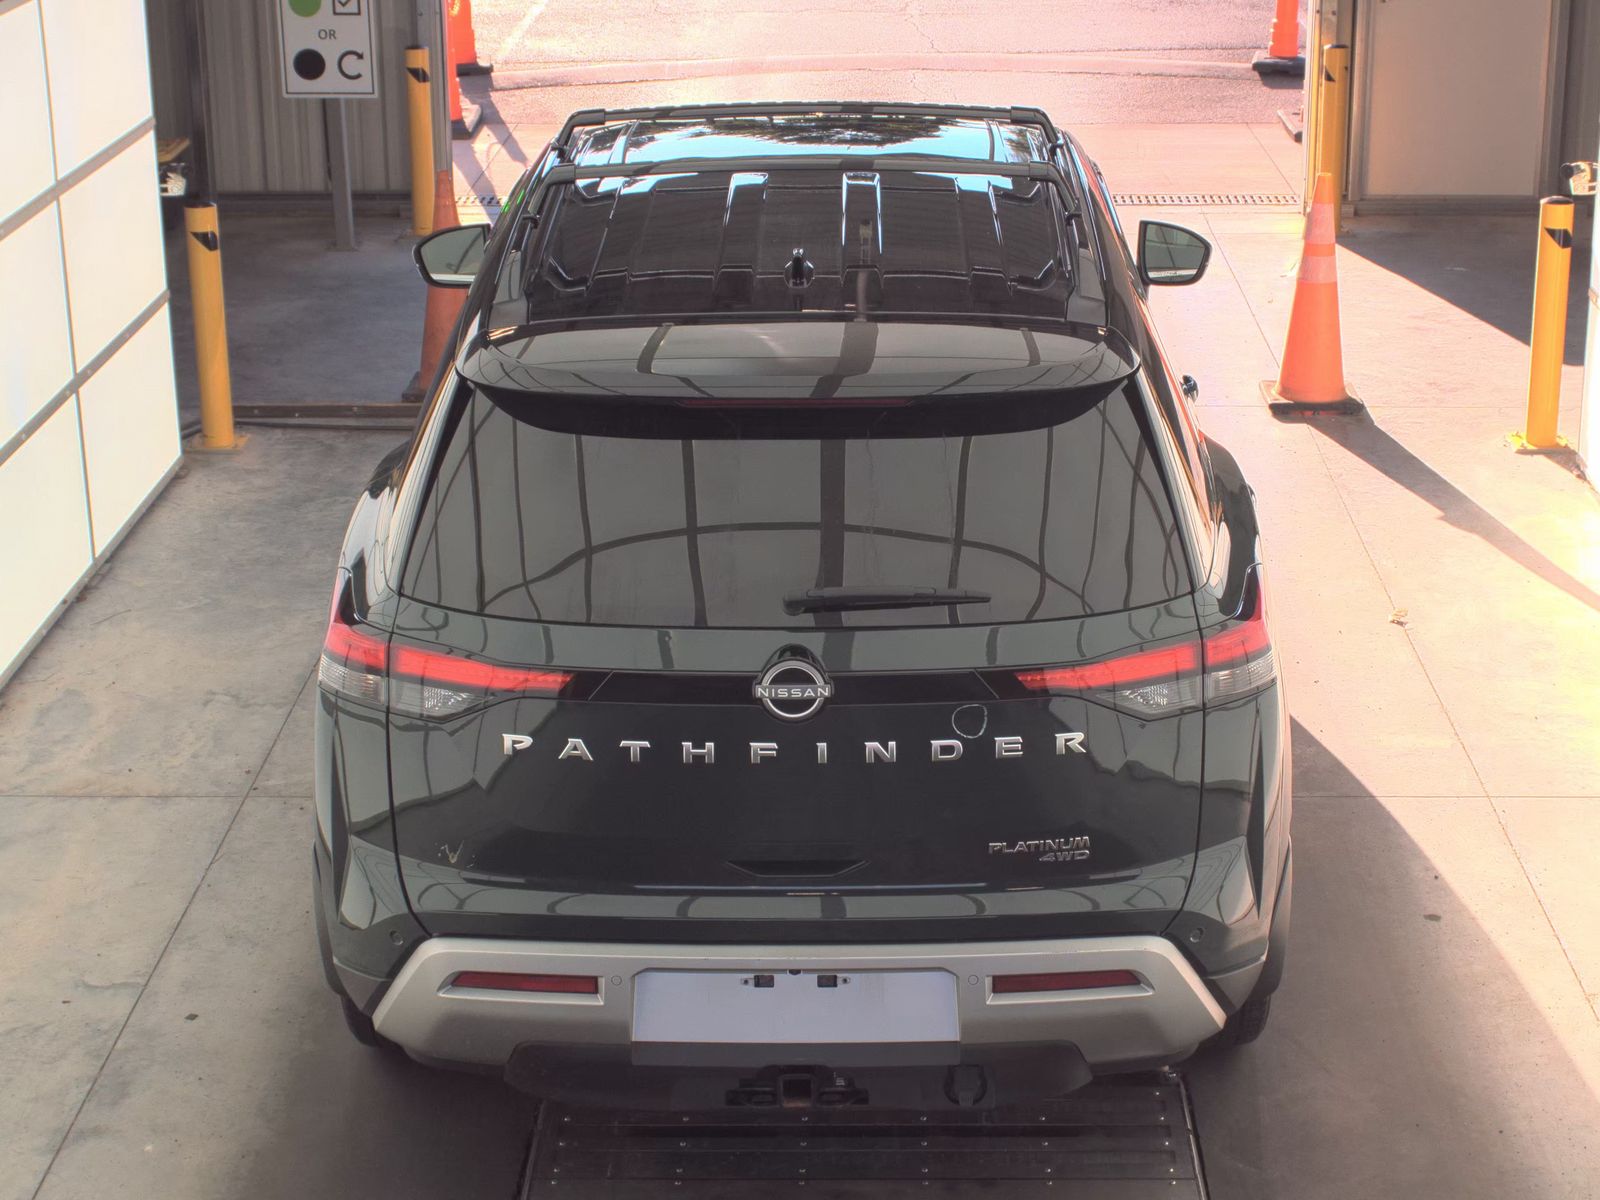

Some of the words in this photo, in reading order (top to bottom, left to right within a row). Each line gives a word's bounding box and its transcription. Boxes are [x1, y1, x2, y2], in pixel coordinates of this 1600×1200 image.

[318, 29, 336, 40] OR
[757, 687, 829, 698] NISSAN
[502, 732, 1087, 764] PATHFINDER
[988, 836, 1091, 854] PLATINUM
[1039, 849, 1090, 862] 4WD
